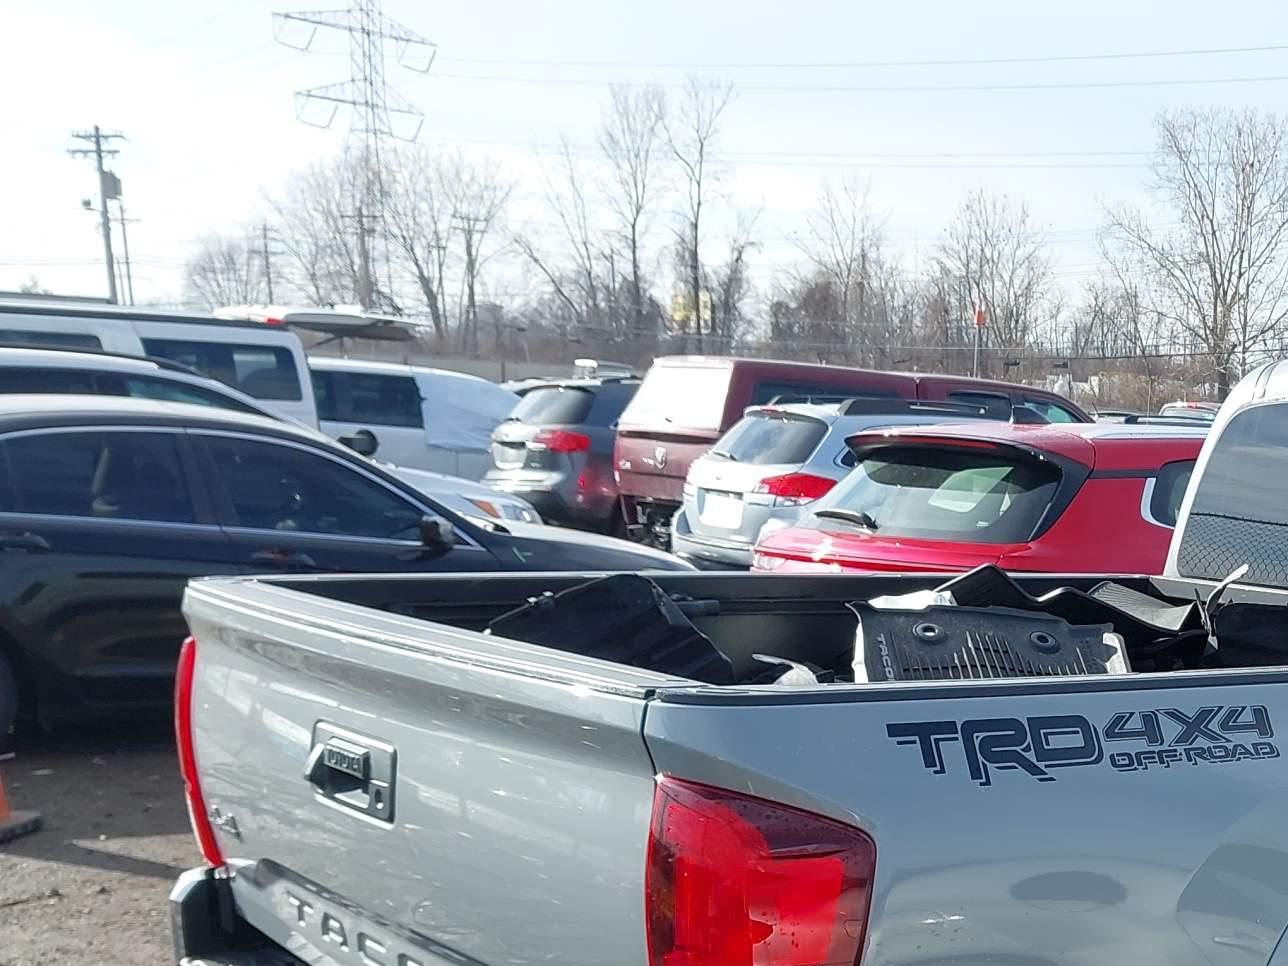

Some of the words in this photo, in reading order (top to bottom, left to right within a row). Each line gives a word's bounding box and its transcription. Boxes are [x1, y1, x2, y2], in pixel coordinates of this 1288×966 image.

[876, 633, 895, 681] TACO
[886, 713, 1104, 787] TRD
[1109, 748, 1183, 772] OFF
[1183, 741, 1281, 766] ROAD
